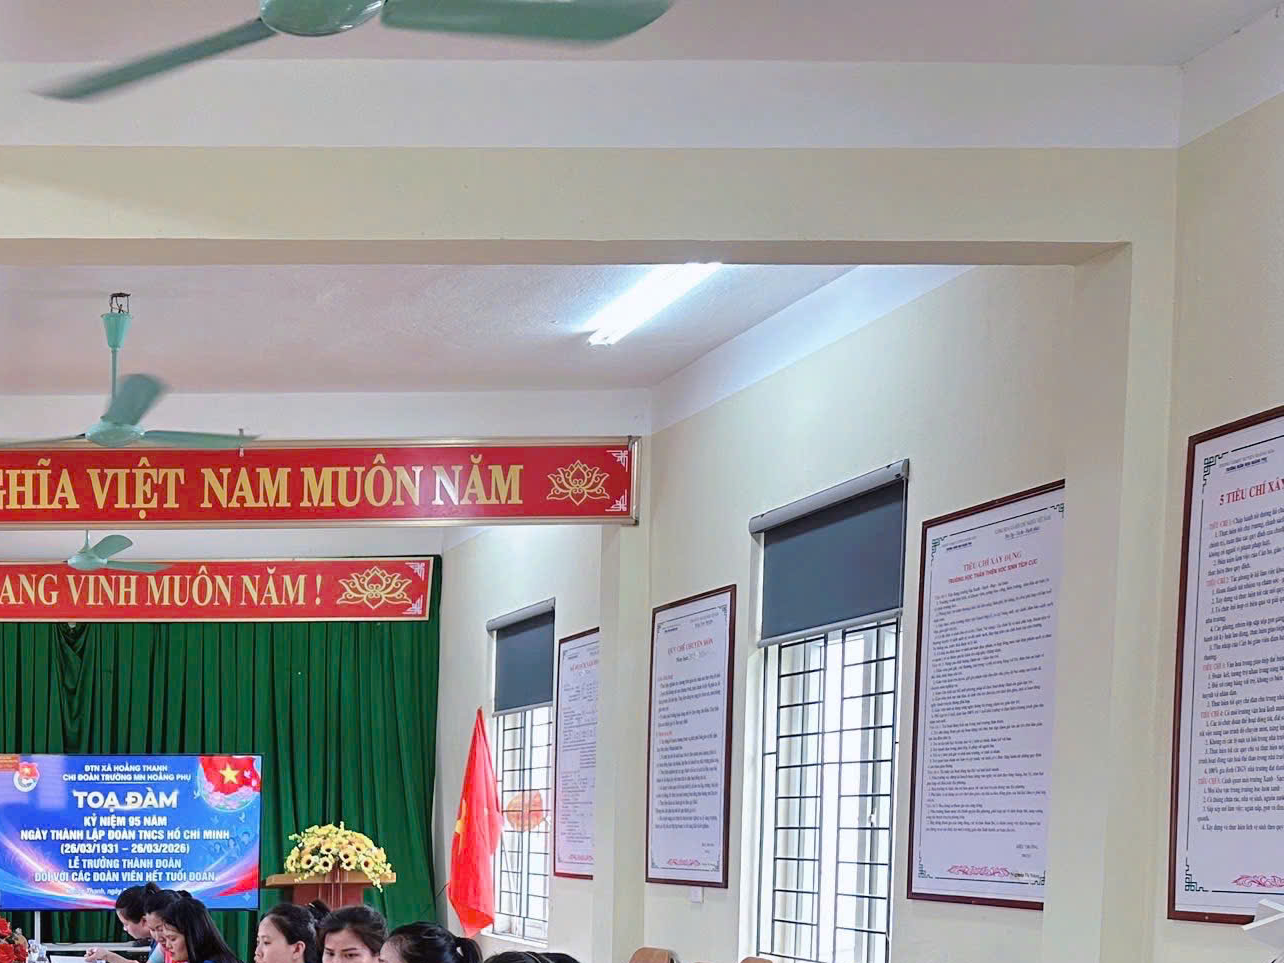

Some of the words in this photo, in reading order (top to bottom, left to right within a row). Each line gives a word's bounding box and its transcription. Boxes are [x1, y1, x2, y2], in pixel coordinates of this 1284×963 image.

[86, 457, 185, 519] VIỆT
[201, 467, 291, 508] NAM
[300, 454, 422, 507] MUÔN
[432, 454, 523, 505] NĂM
[66, 574, 137, 605] VINH
[145, 566, 232, 607] MUÔN
[241, 566, 307, 607] NĂM
[73, 790, 121, 813] TOẠ
[125, 787, 178, 808] ĐÀM
[99, 814, 126, 829] NIỆM
[128, 816, 141, 827] 95
[20, 827, 48, 841] NGÀY
[50, 827, 84, 841] THÀNH
[86, 828, 105, 842] LẬP
[107, 828, 136, 841] ĐOÀN
[137, 829, 165, 841] TNCS
[203, 829, 230, 841] MINH
[60, 843, 119, 855] (26/03/1931
[131, 843, 190, 855] 26/03/2026)
[122, 857, 154, 869] THÀNH
[155, 857, 182, 869] ĐOÀN
[71, 870, 91, 882] CÁC
[92, 870, 120, 882] ĐOÀN
[121, 870, 144, 882] VIÊN
[145, 869, 163, 882] HẾT
